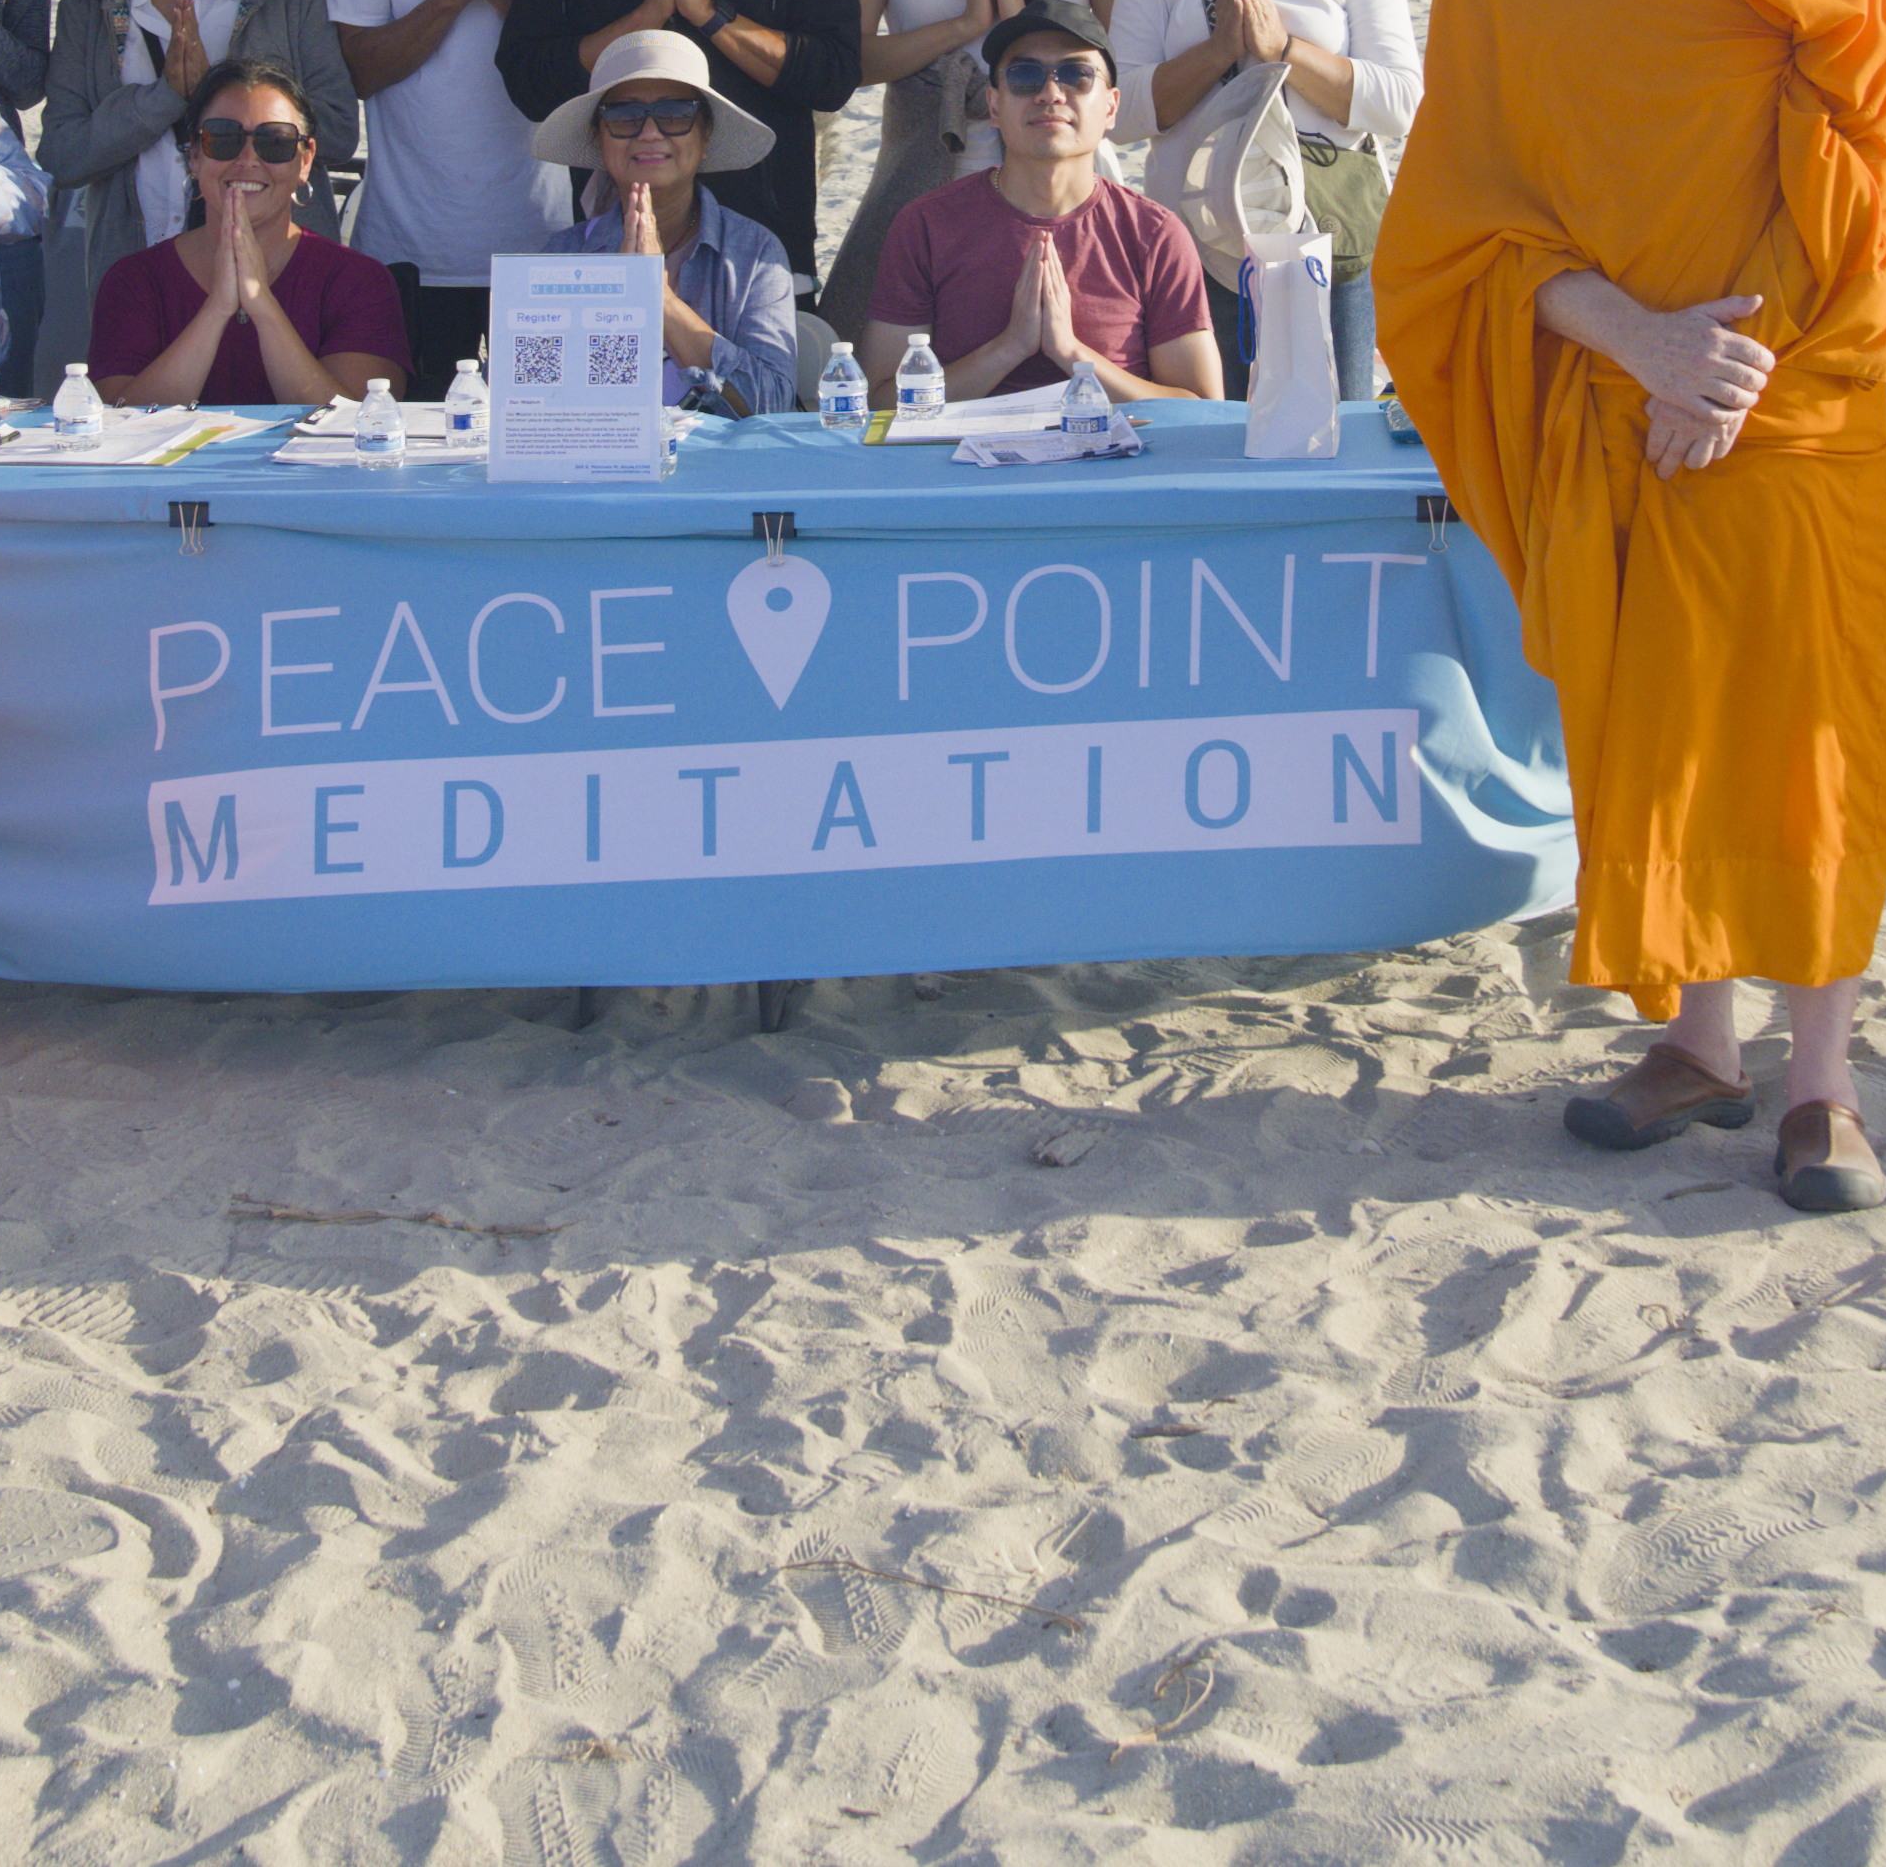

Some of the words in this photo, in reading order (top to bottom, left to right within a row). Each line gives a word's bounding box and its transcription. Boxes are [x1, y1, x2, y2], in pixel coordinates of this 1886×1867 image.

[532, 285, 624, 293] MEDITATION
[517, 312, 562, 324] Register
[595, 312, 619, 323] Sign
[623, 313, 633, 322] in
[150, 585, 676, 751] PEACE
[898, 552, 1427, 701] POINT
[164, 731, 1399, 887] MEDITATION
